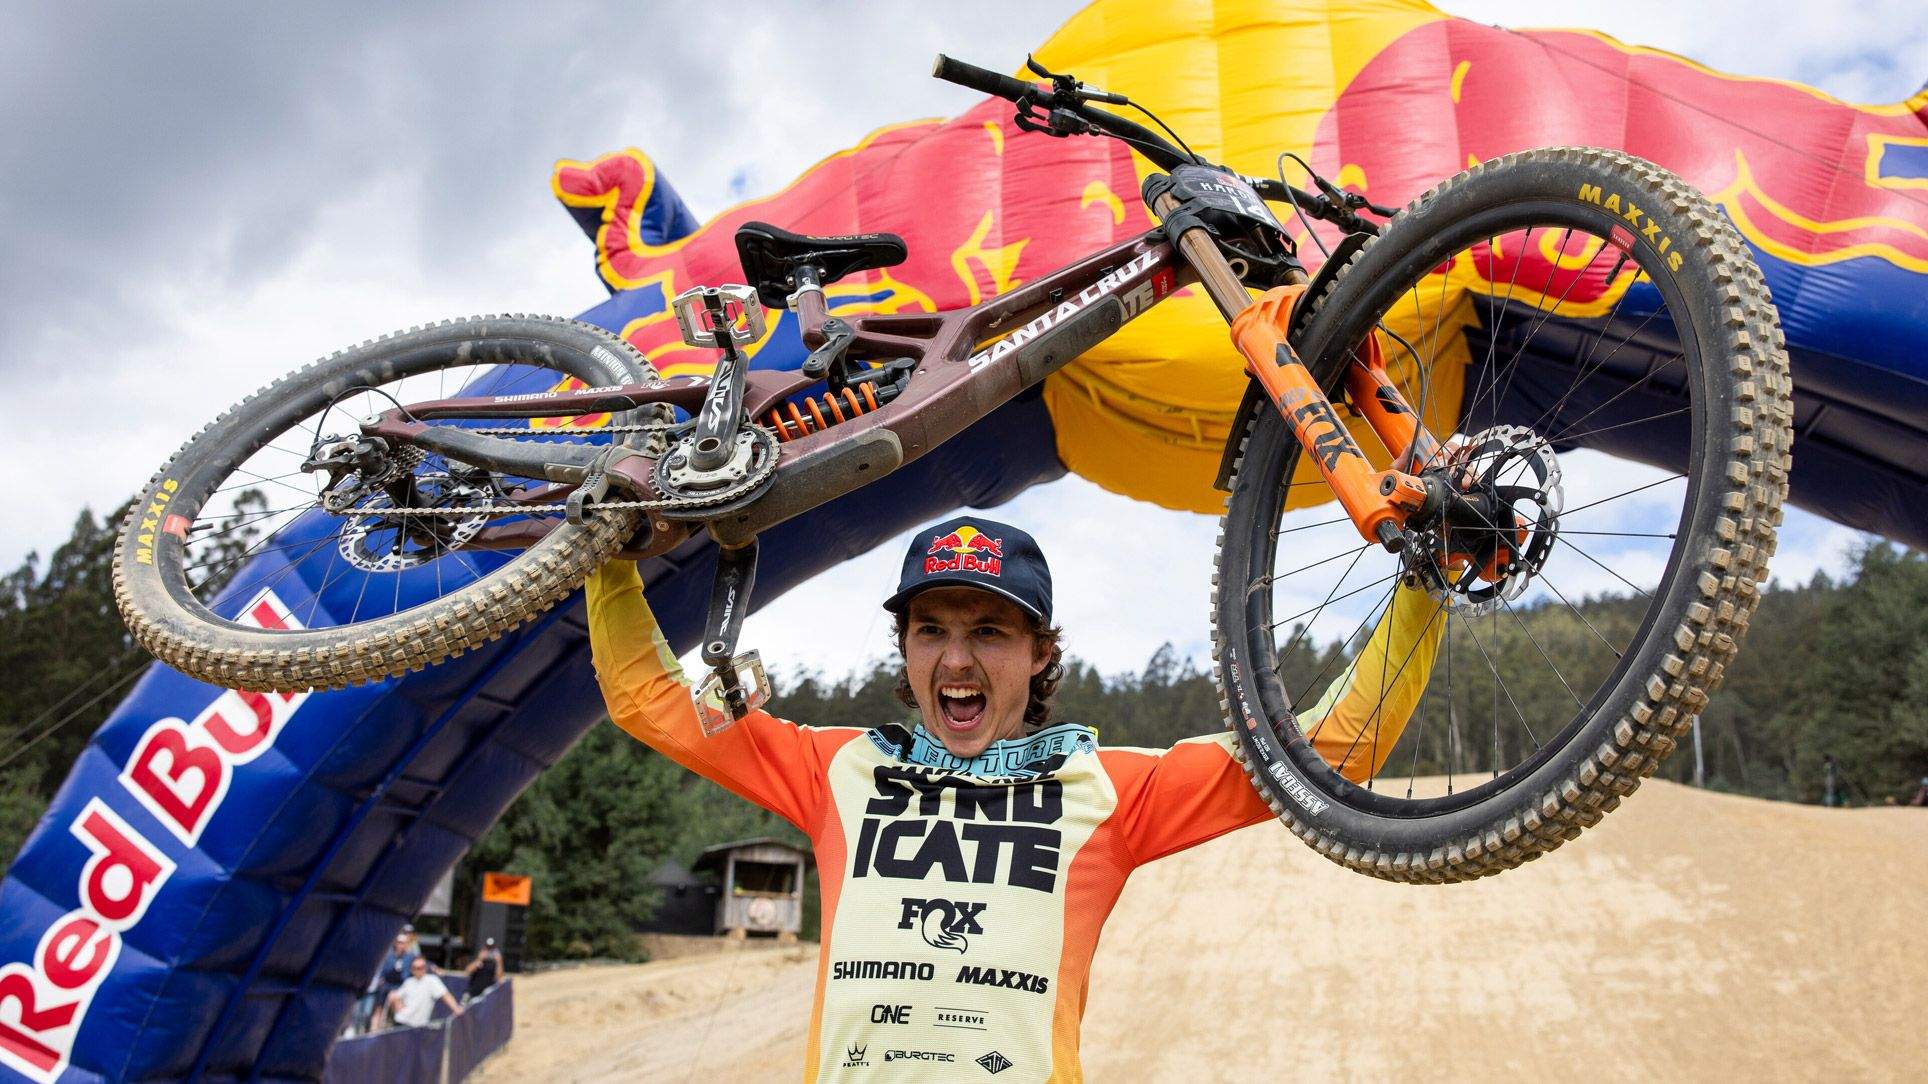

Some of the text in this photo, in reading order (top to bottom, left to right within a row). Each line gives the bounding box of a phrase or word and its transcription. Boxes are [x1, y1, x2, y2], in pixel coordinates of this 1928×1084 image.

[1578, 183, 1684, 272] MAXXIS
[968, 249, 1160, 375] SANTA CRUZ
[494, 392, 558, 404] SHIMANO
[575, 385, 624, 396] MAXXIS
[1294, 400, 1362, 474] FOX
[136, 478, 178, 565] MAXXIS
[924, 552, 1002, 577] Red Bull
[923, 736, 1065, 774] FUTURE
[865, 765, 1064, 825] SYND
[1268, 760, 1329, 817] ASSEGAI
[853, 818, 1062, 894] ICATE
[0, 801, 171, 1080] Red
[897, 897, 987, 946] FOX
[833, 960, 935, 981] SHIMANO
[955, 965, 1049, 995] MAXXIS
[871, 1004, 912, 1024] ONE
[938, 1013, 985, 1025] RESERVE
[894, 1050, 955, 1063] BURGTEC
